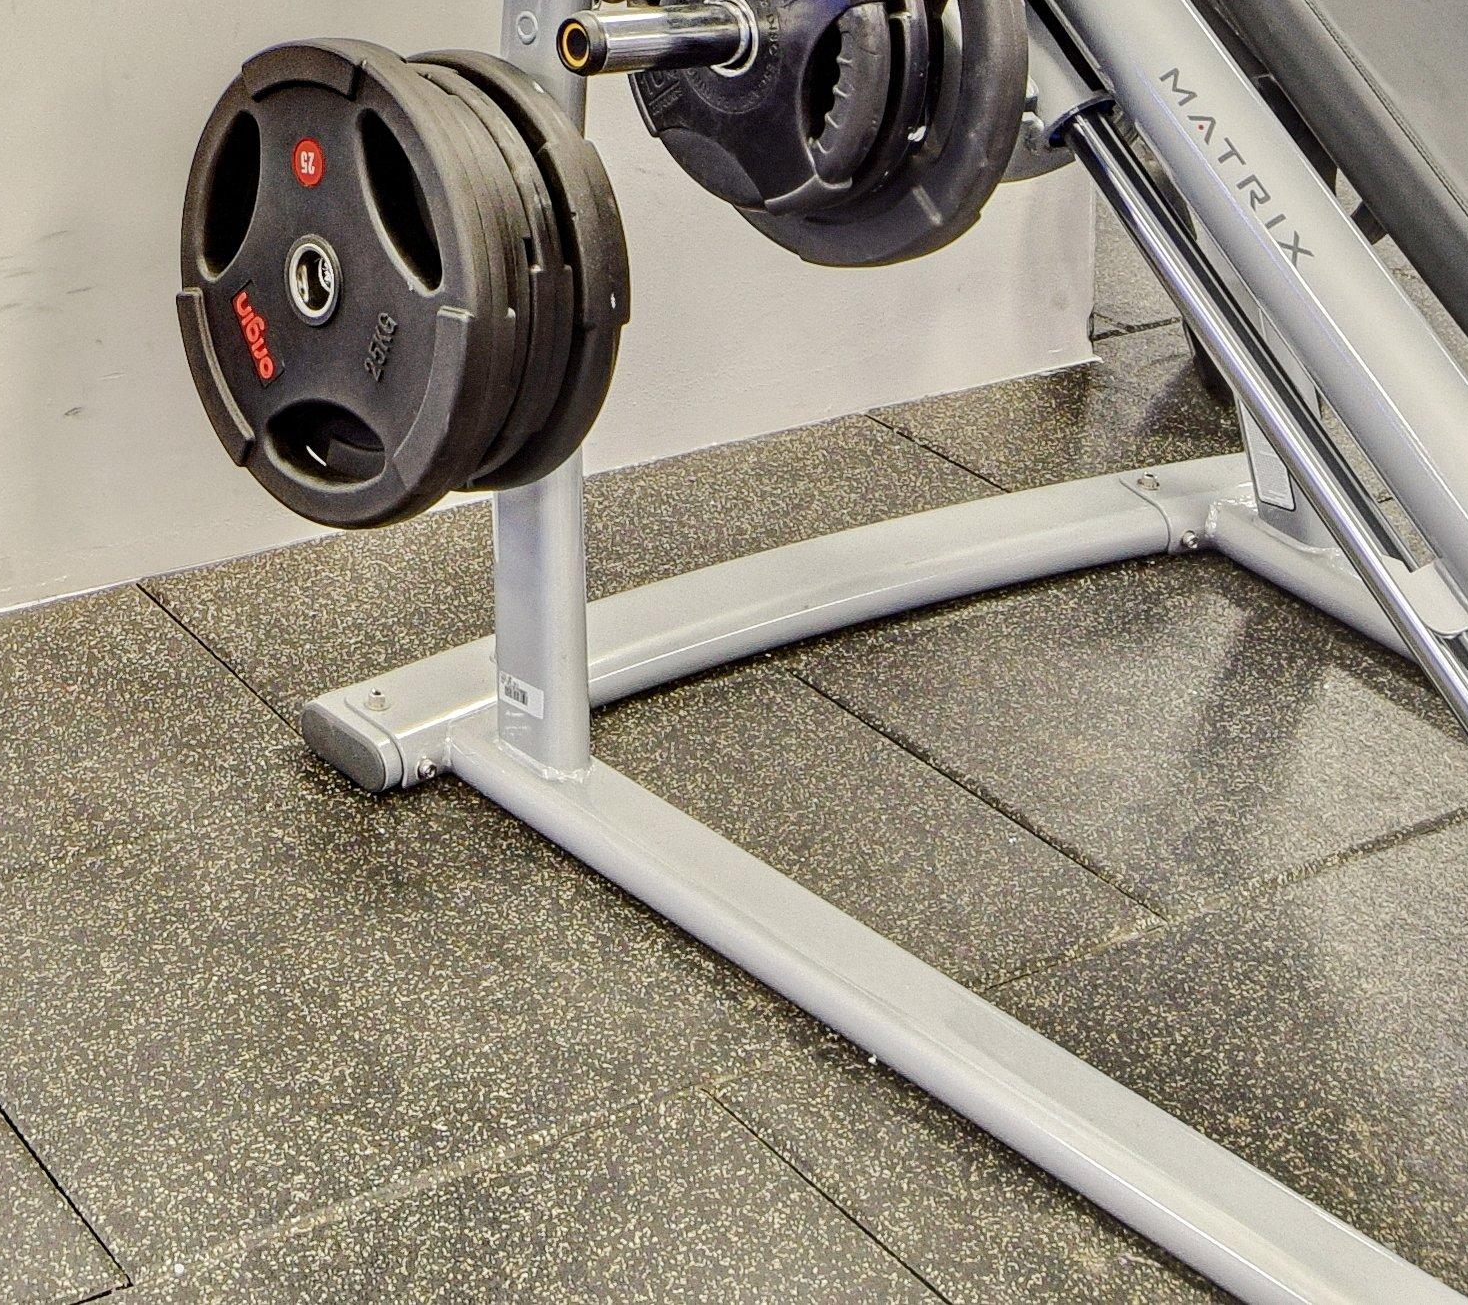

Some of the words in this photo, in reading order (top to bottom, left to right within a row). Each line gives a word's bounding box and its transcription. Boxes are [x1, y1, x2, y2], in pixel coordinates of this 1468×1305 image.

[300, 150, 316, 175] 25
[1158, 67, 1315, 268] MATRIX
[234, 291, 275, 380] origin
[365, 312, 399, 383] 25KG
